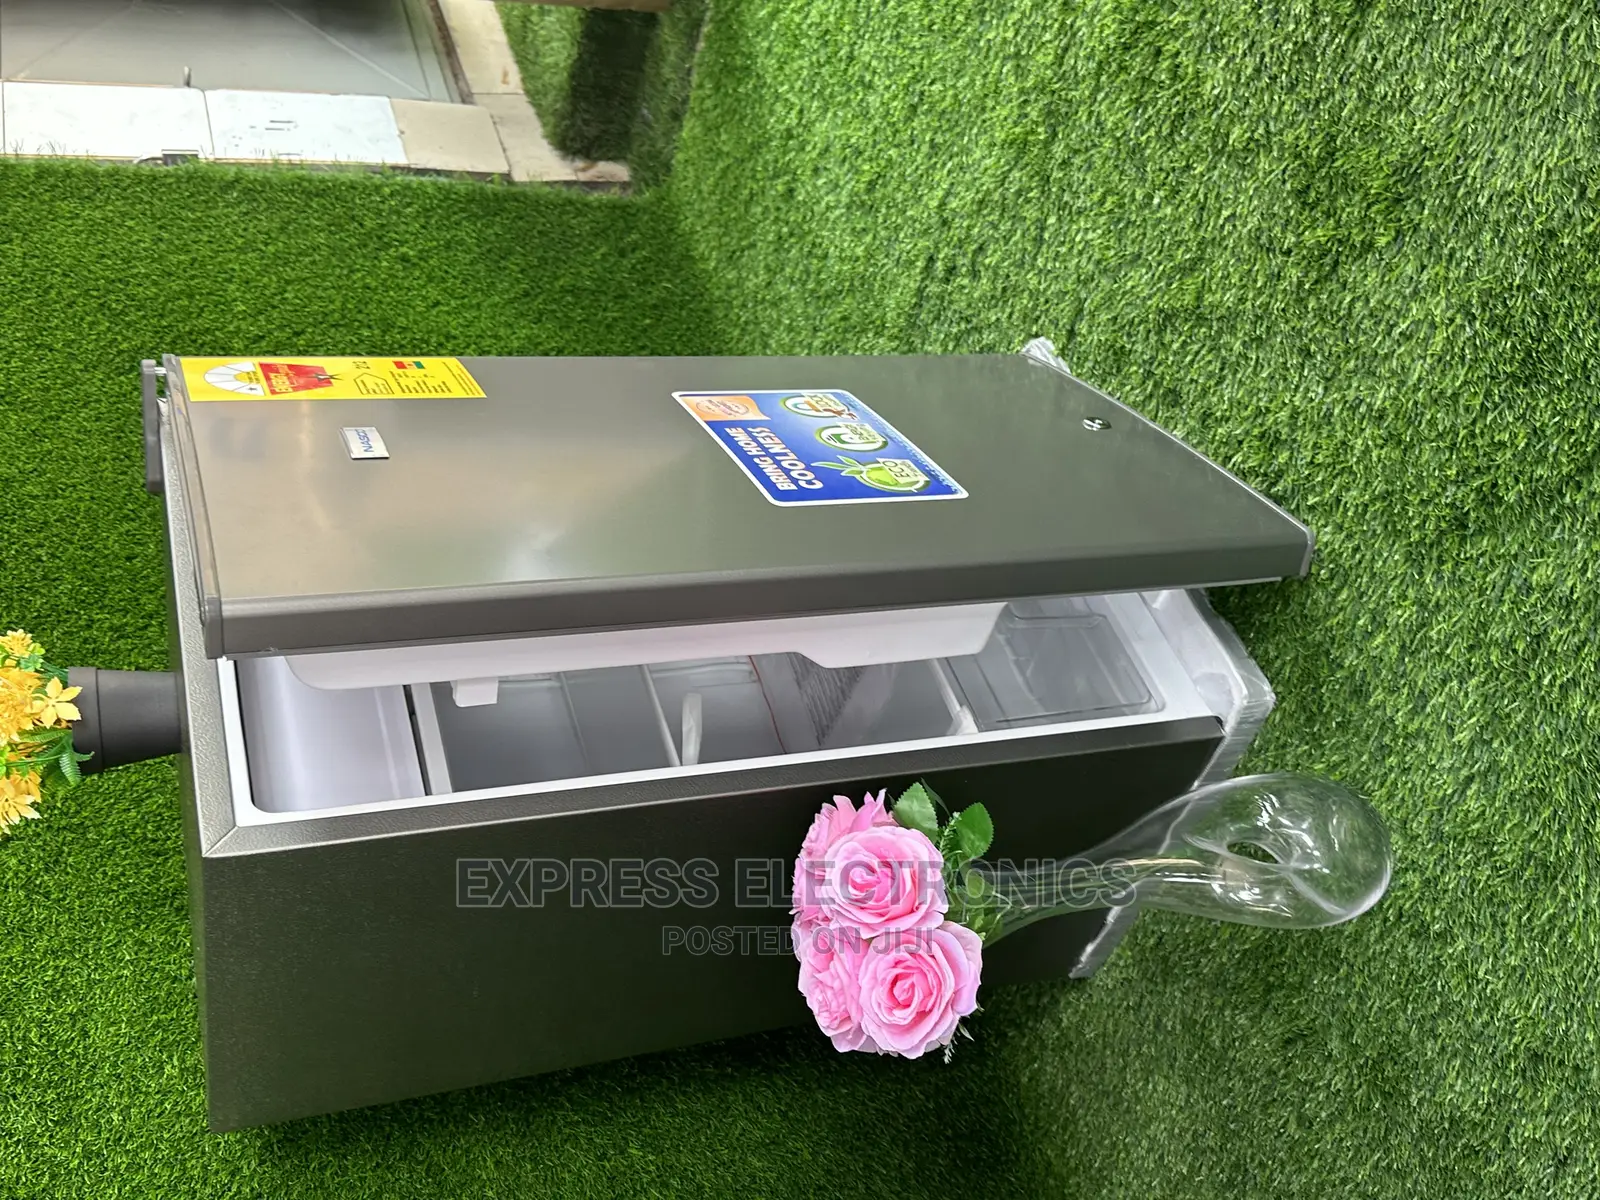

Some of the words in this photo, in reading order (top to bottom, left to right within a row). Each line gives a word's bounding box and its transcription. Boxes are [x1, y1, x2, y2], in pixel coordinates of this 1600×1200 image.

[355, 429, 374, 453] NASCO
[724, 427, 766, 456] HOME
[747, 426, 825, 490] COOLNESS
[882, 460, 911, 478] ECO
[753, 457, 798, 491] BRING
